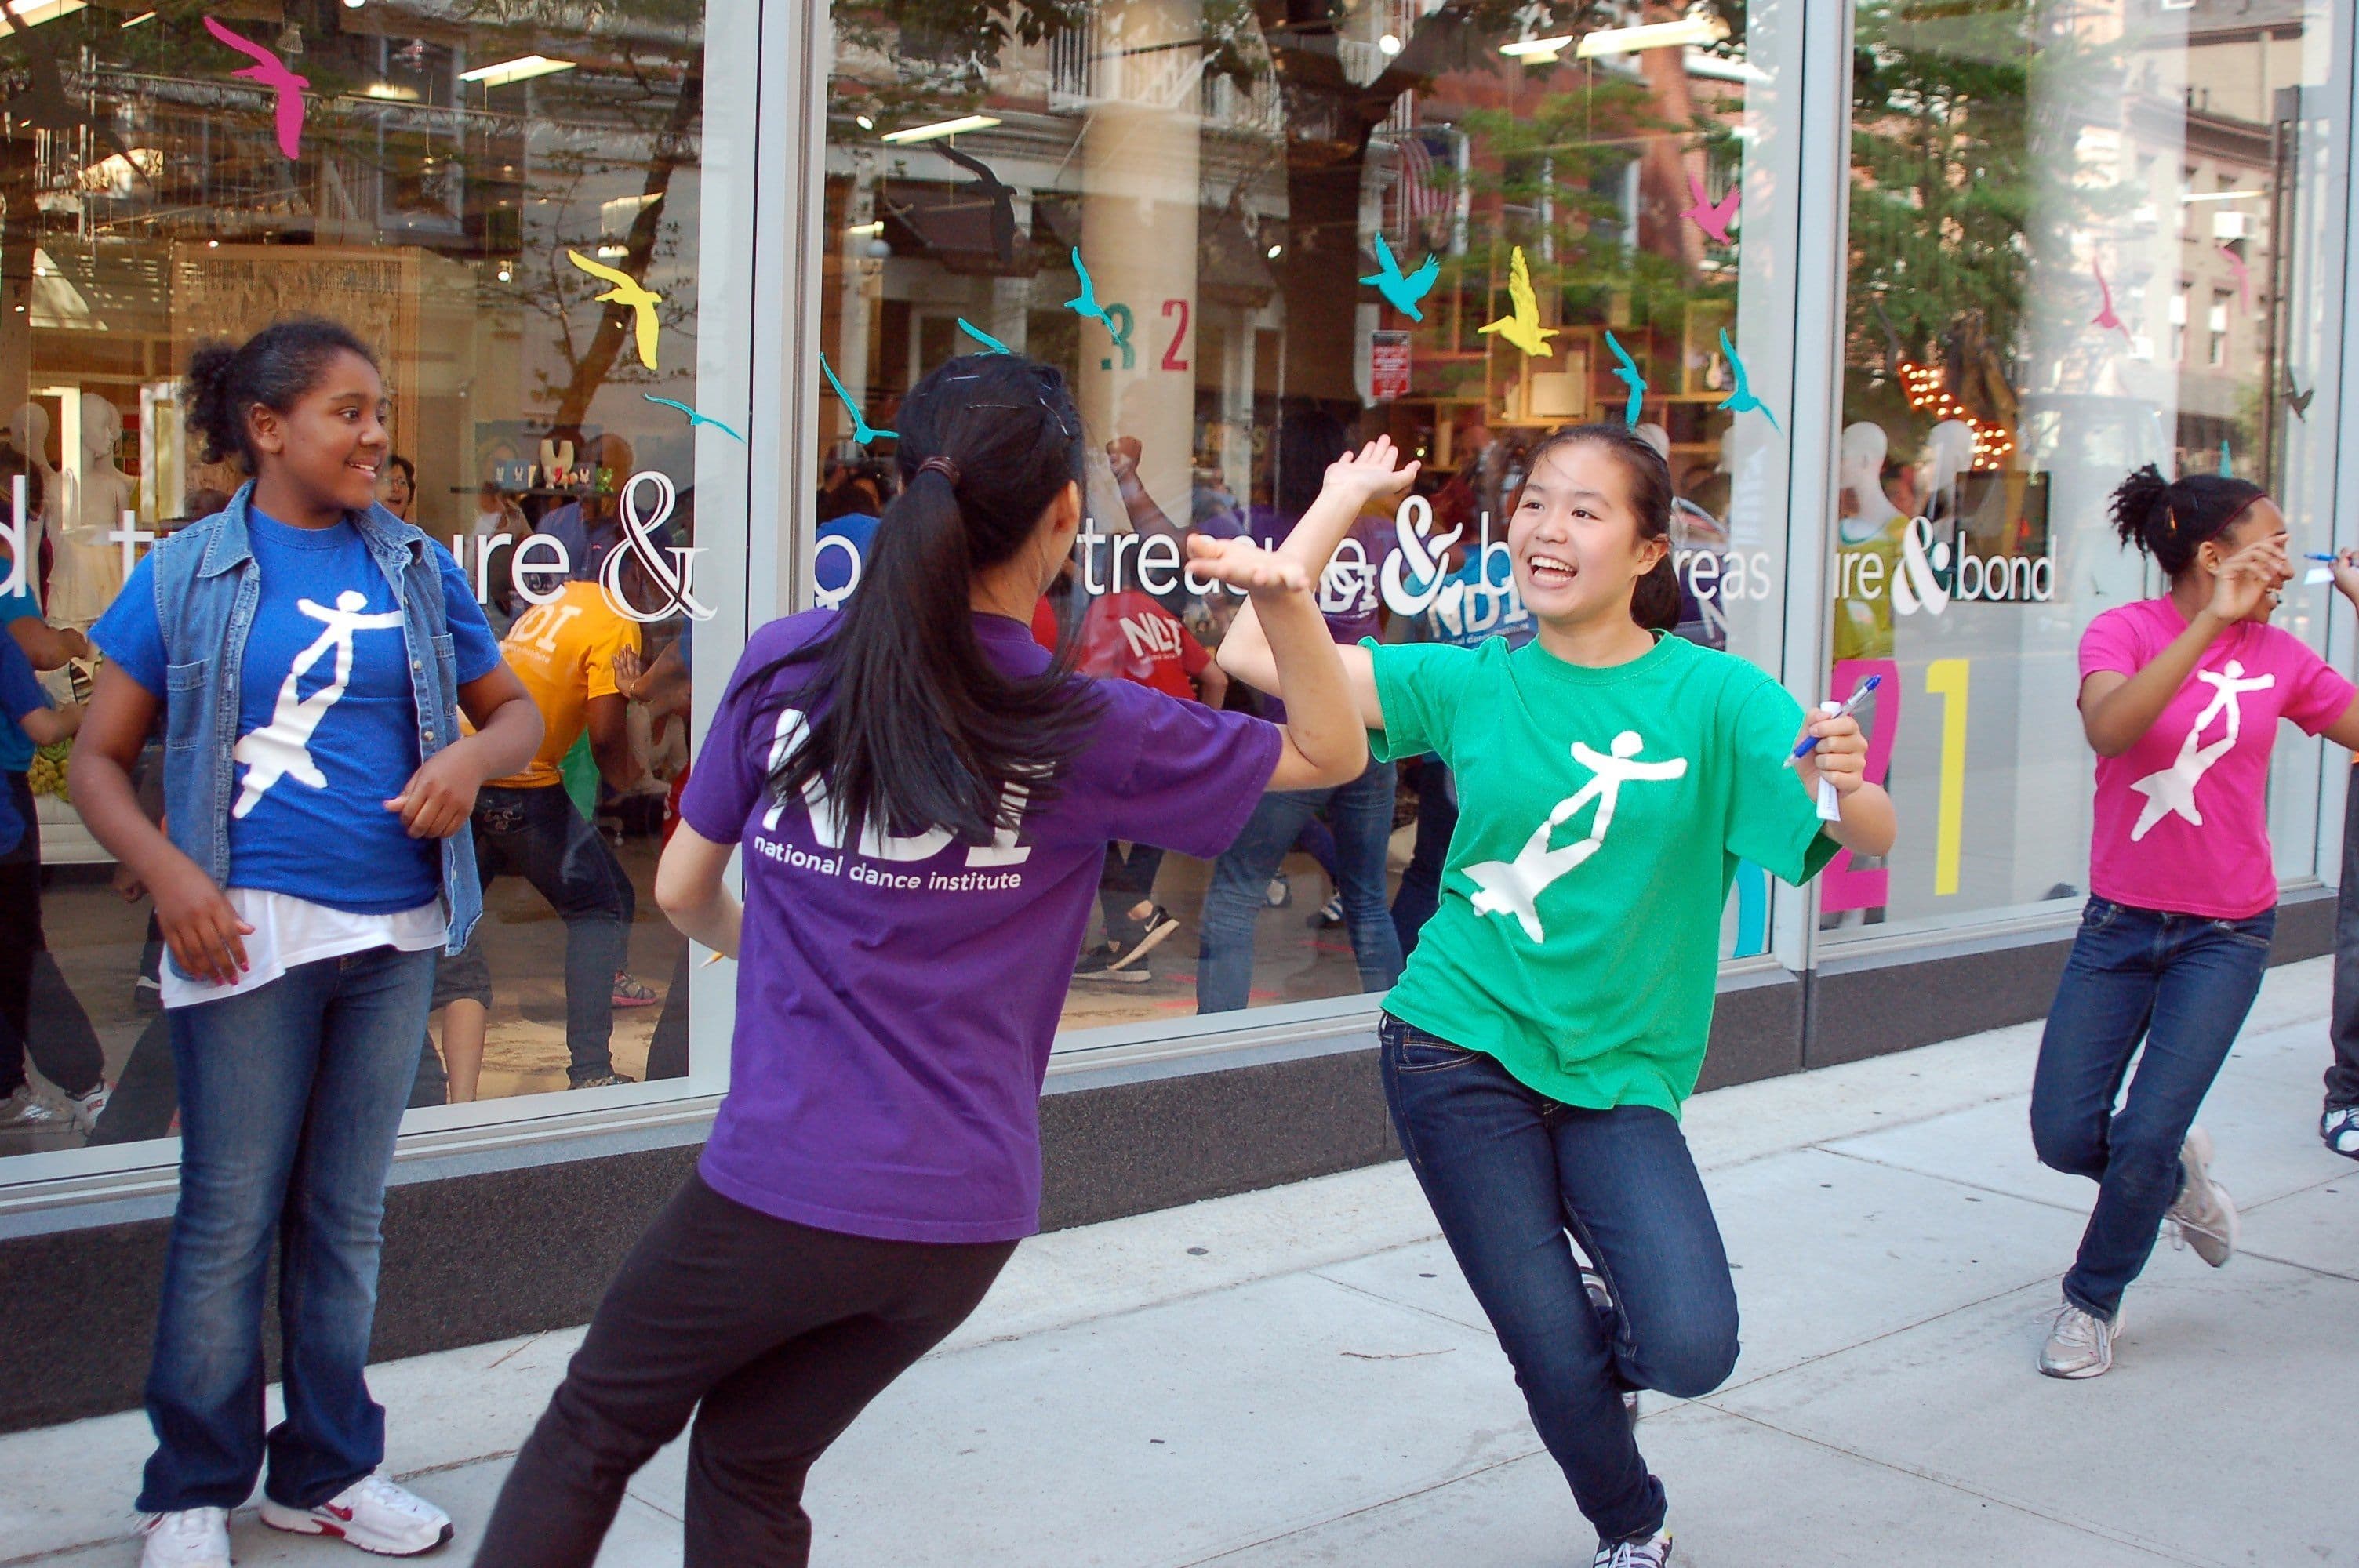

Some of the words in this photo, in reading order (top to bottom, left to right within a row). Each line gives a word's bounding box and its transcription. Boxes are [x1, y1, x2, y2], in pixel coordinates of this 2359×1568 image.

[1161, 299, 1187, 370] 2
[453, 532, 570, 605] re
[598, 470, 718, 622] &
[1380, 495, 1463, 616] &
[1674, 549, 1771, 601] reas
[1891, 516, 1951, 615] &
[1957, 531, 2056, 601] bond
[1319, 562, 1379, 612] DI
[1925, 659, 1970, 897] 1
[754, 835, 843, 877] national
[849, 863, 921, 890] dance
[928, 872, 1022, 892] institute
